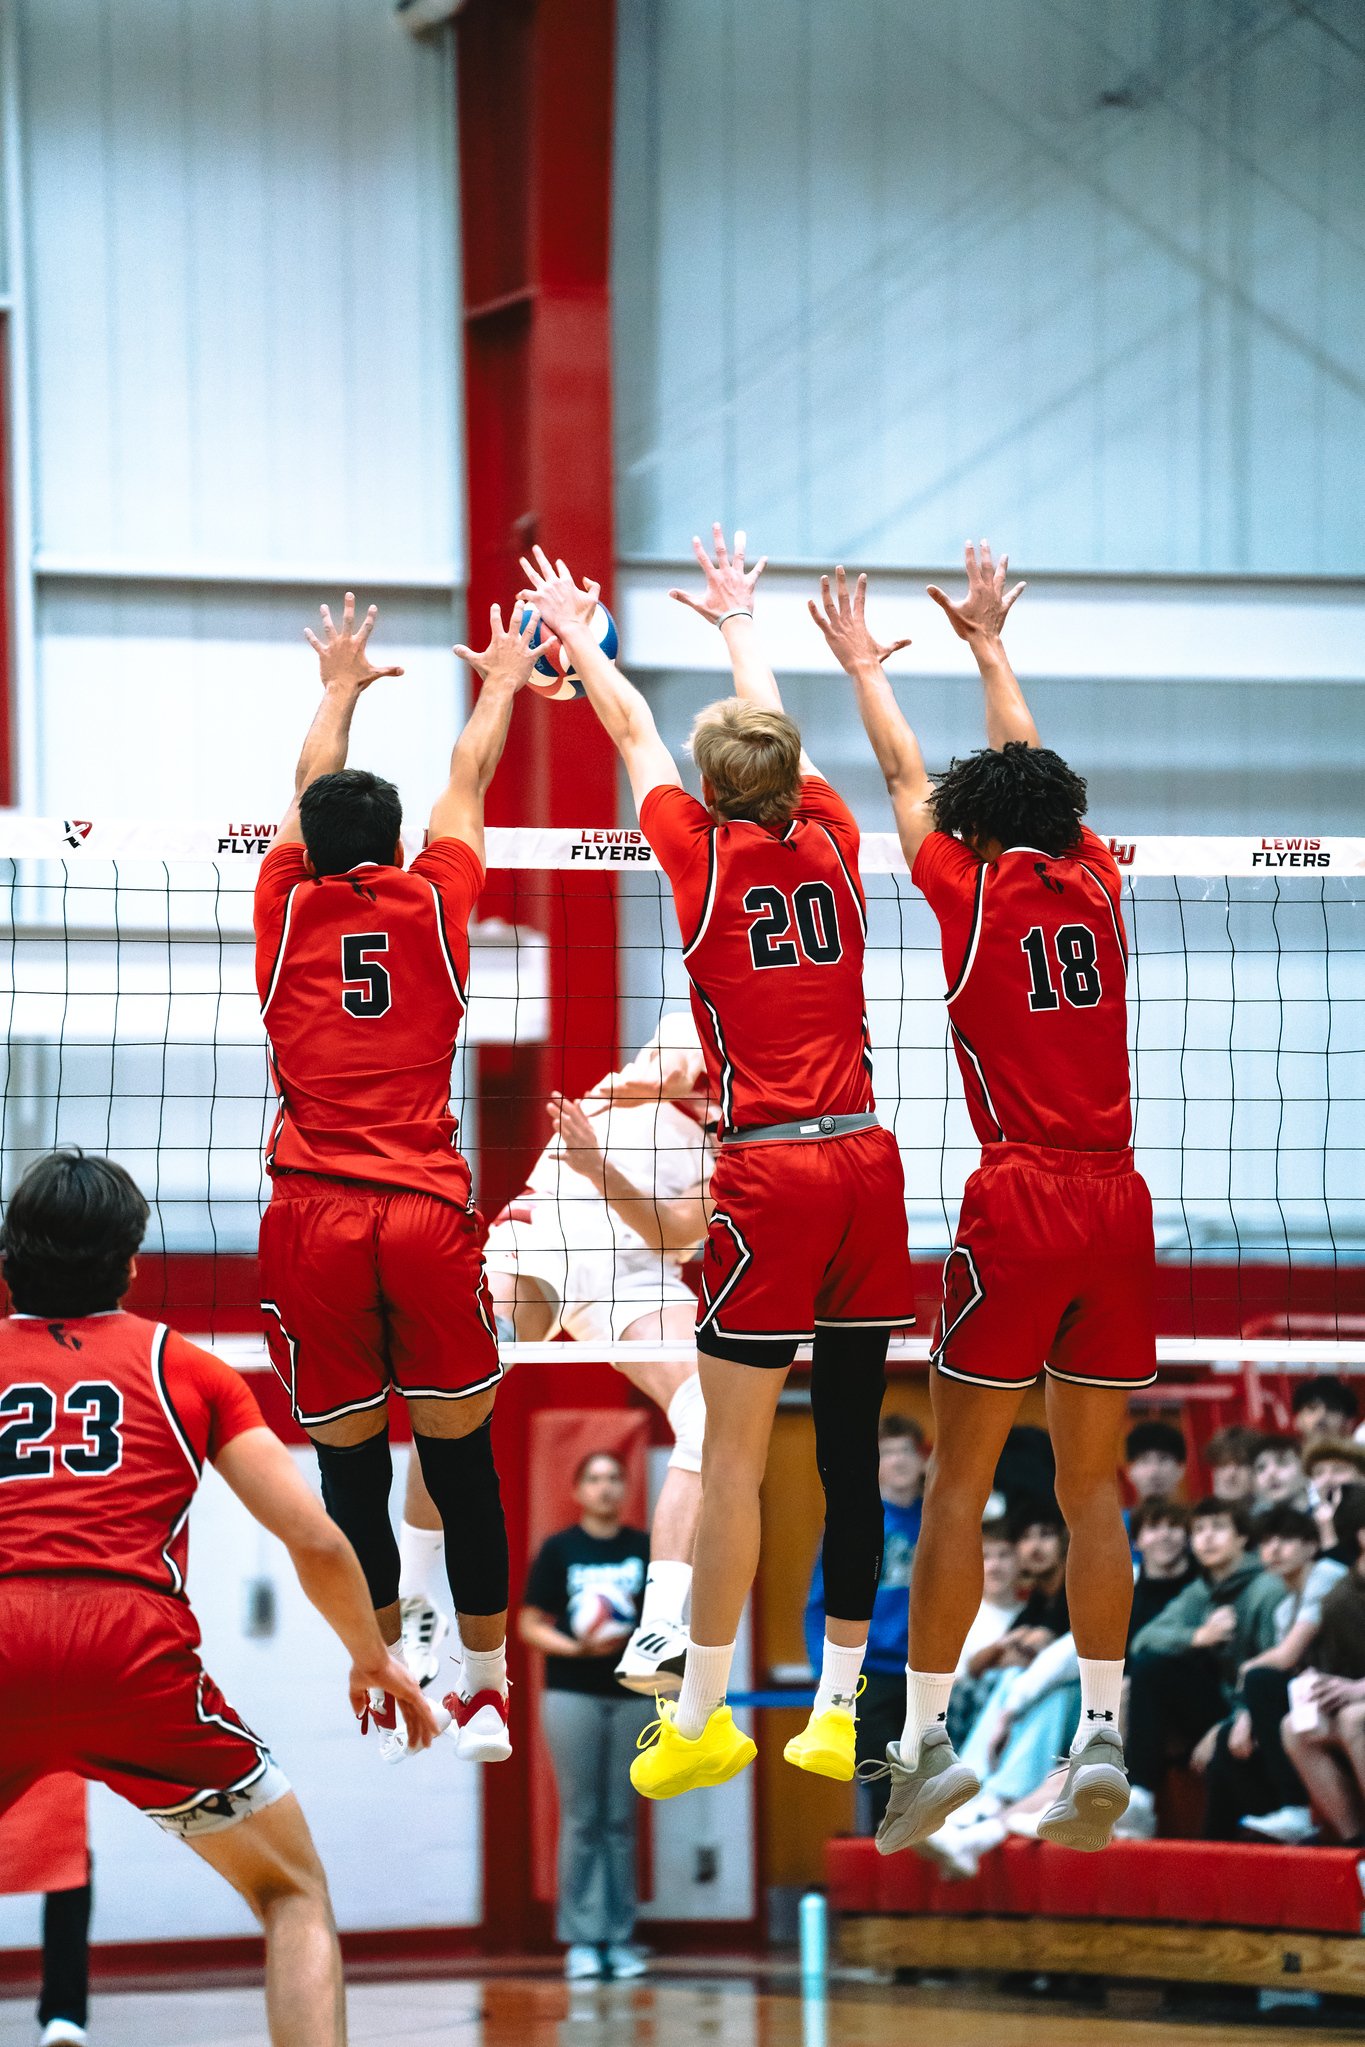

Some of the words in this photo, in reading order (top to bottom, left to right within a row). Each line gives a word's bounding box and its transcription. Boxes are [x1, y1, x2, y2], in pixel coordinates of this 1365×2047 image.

[228, 823, 278, 837] LEWI
[581, 830, 642, 844] LEWIS
[217, 838, 272, 854] FLYE
[1261, 838, 1321, 851] LEWIS
[570, 845, 652, 861] FLYERS
[1252, 852, 1331, 867] FLYERS
[742, 880, 844, 971] 20
[341, 932, 392, 1018] 5
[1020, 923, 1103, 1012] 18
[0, 1380, 124, 1484] 23
